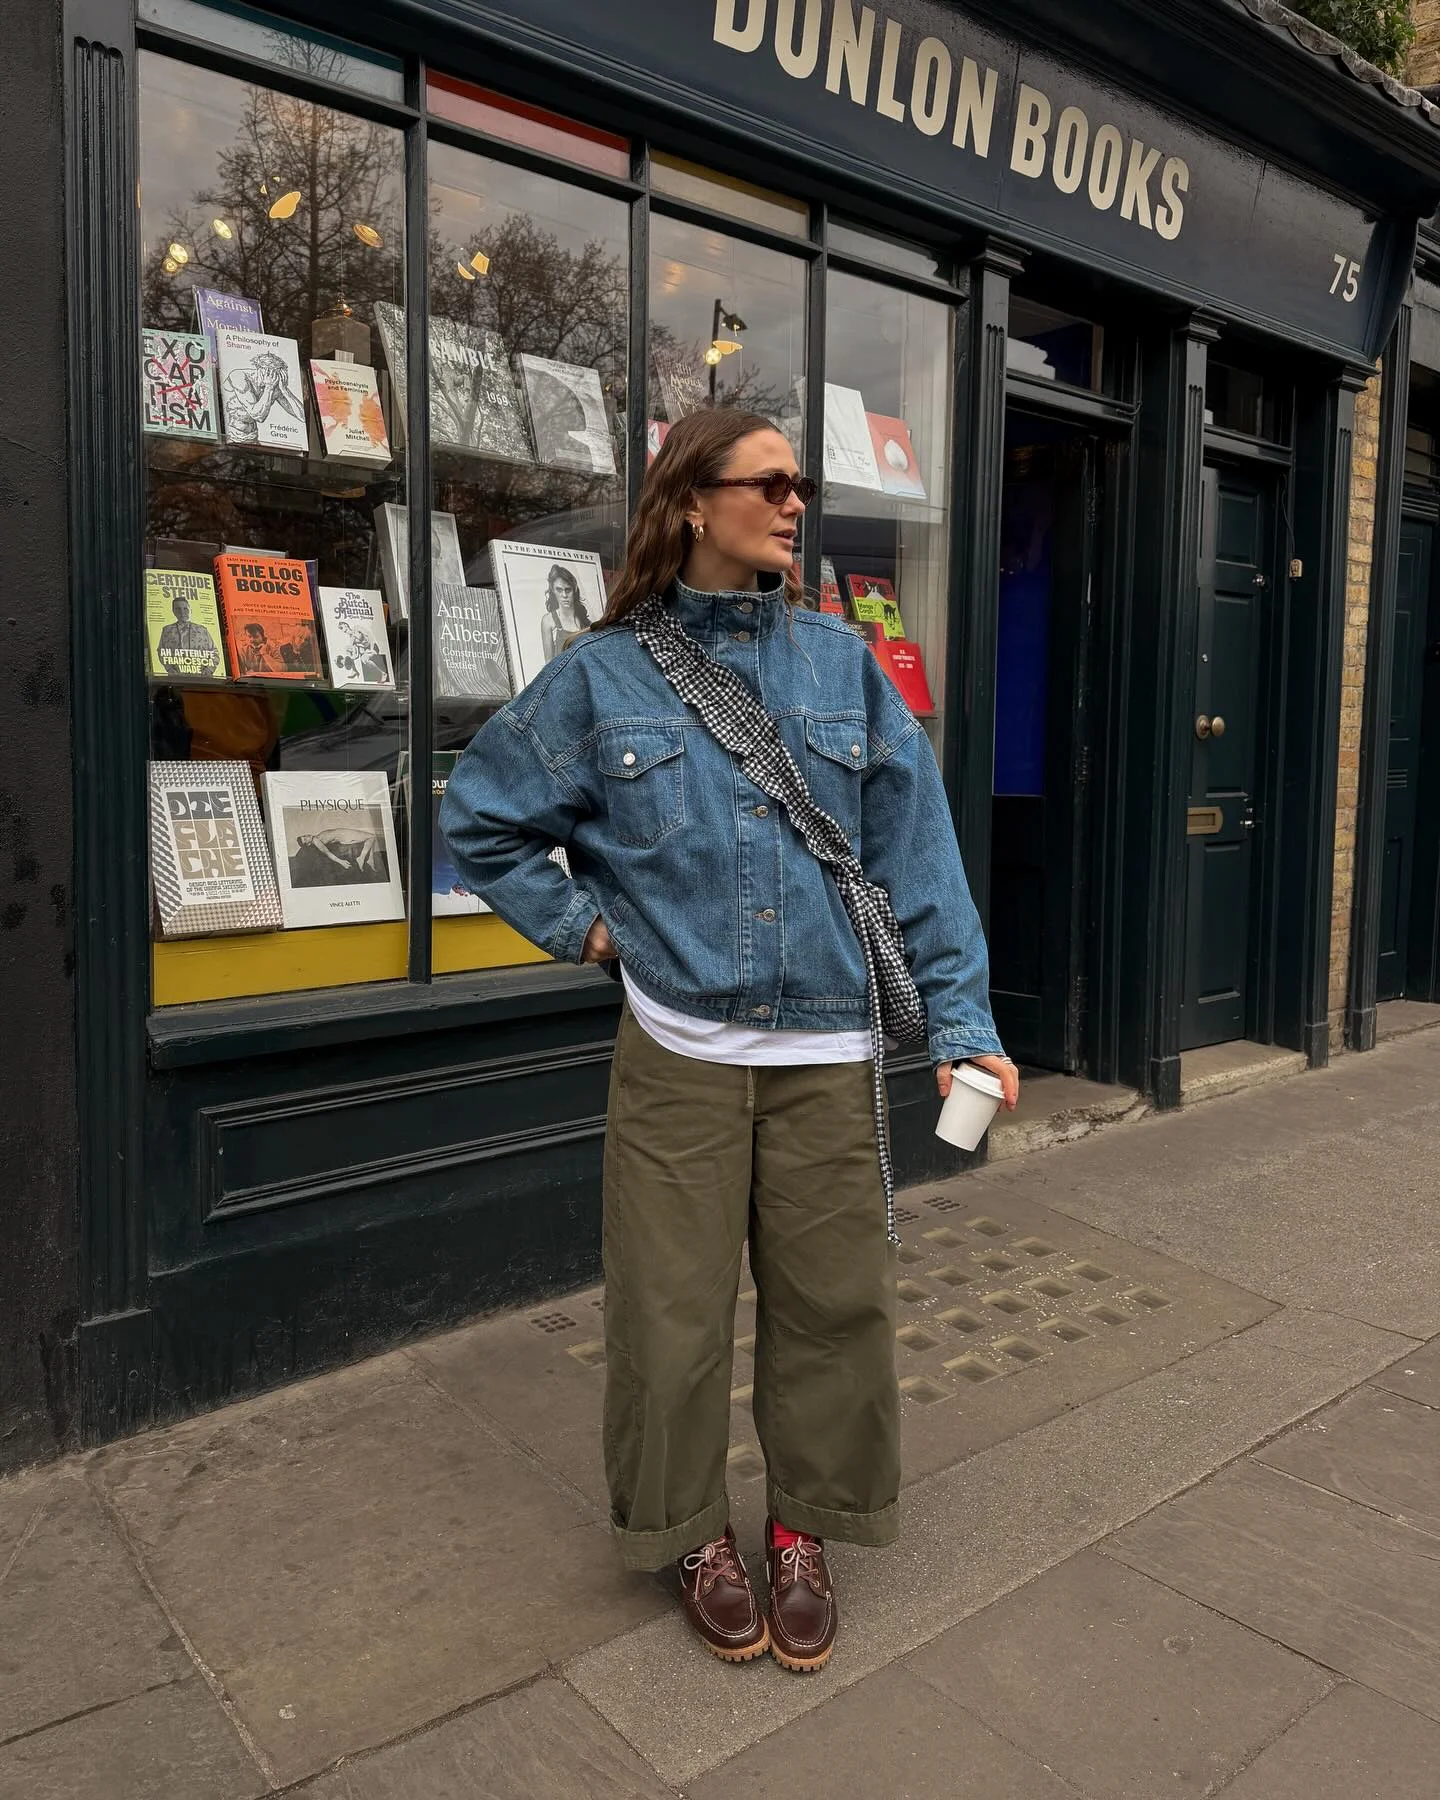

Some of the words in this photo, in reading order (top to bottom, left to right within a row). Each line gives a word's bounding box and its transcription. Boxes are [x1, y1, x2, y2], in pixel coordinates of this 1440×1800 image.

[1010, 83, 1190, 241] BOOKS
[1329, 253, 1361, 302] 75
[206, 295, 254, 314] Against
[226, 341, 252, 350] Shame
[232, 335, 271, 347] Philosophy
[142, 335, 206, 364] EXO
[428, 337, 499, 371] RAMBLE
[143, 358, 206, 386] CAP
[324, 378, 369, 389] Psychoanalysis
[340, 386, 369, 395] Feminism
[270, 430, 288, 439] Gros
[515, 545, 530, 553] THE
[532, 547, 572, 558] AMERICAN
[227, 563, 266, 578] THE
[268, 566, 304, 582] LOG
[146, 572, 212, 590] GERTRUDE
[236, 578, 301, 596] BOOKS
[162, 586, 199, 601] STEIN
[345, 591, 361, 600] The
[338, 597, 369, 609] Butch
[437, 600, 482, 621] Anni
[334, 606, 374, 620] Manual
[440, 621, 499, 645] Albers
[160, 648, 172, 657] AN
[174, 648, 216, 659] AFTERLIFE
[442, 646, 497, 662] Constructing
[163, 657, 216, 667] FRANCESCA
[178, 665, 203, 674] WADE
[443, 658, 477, 671] Textiles
[300, 798, 365, 814] PHYSIQUE
